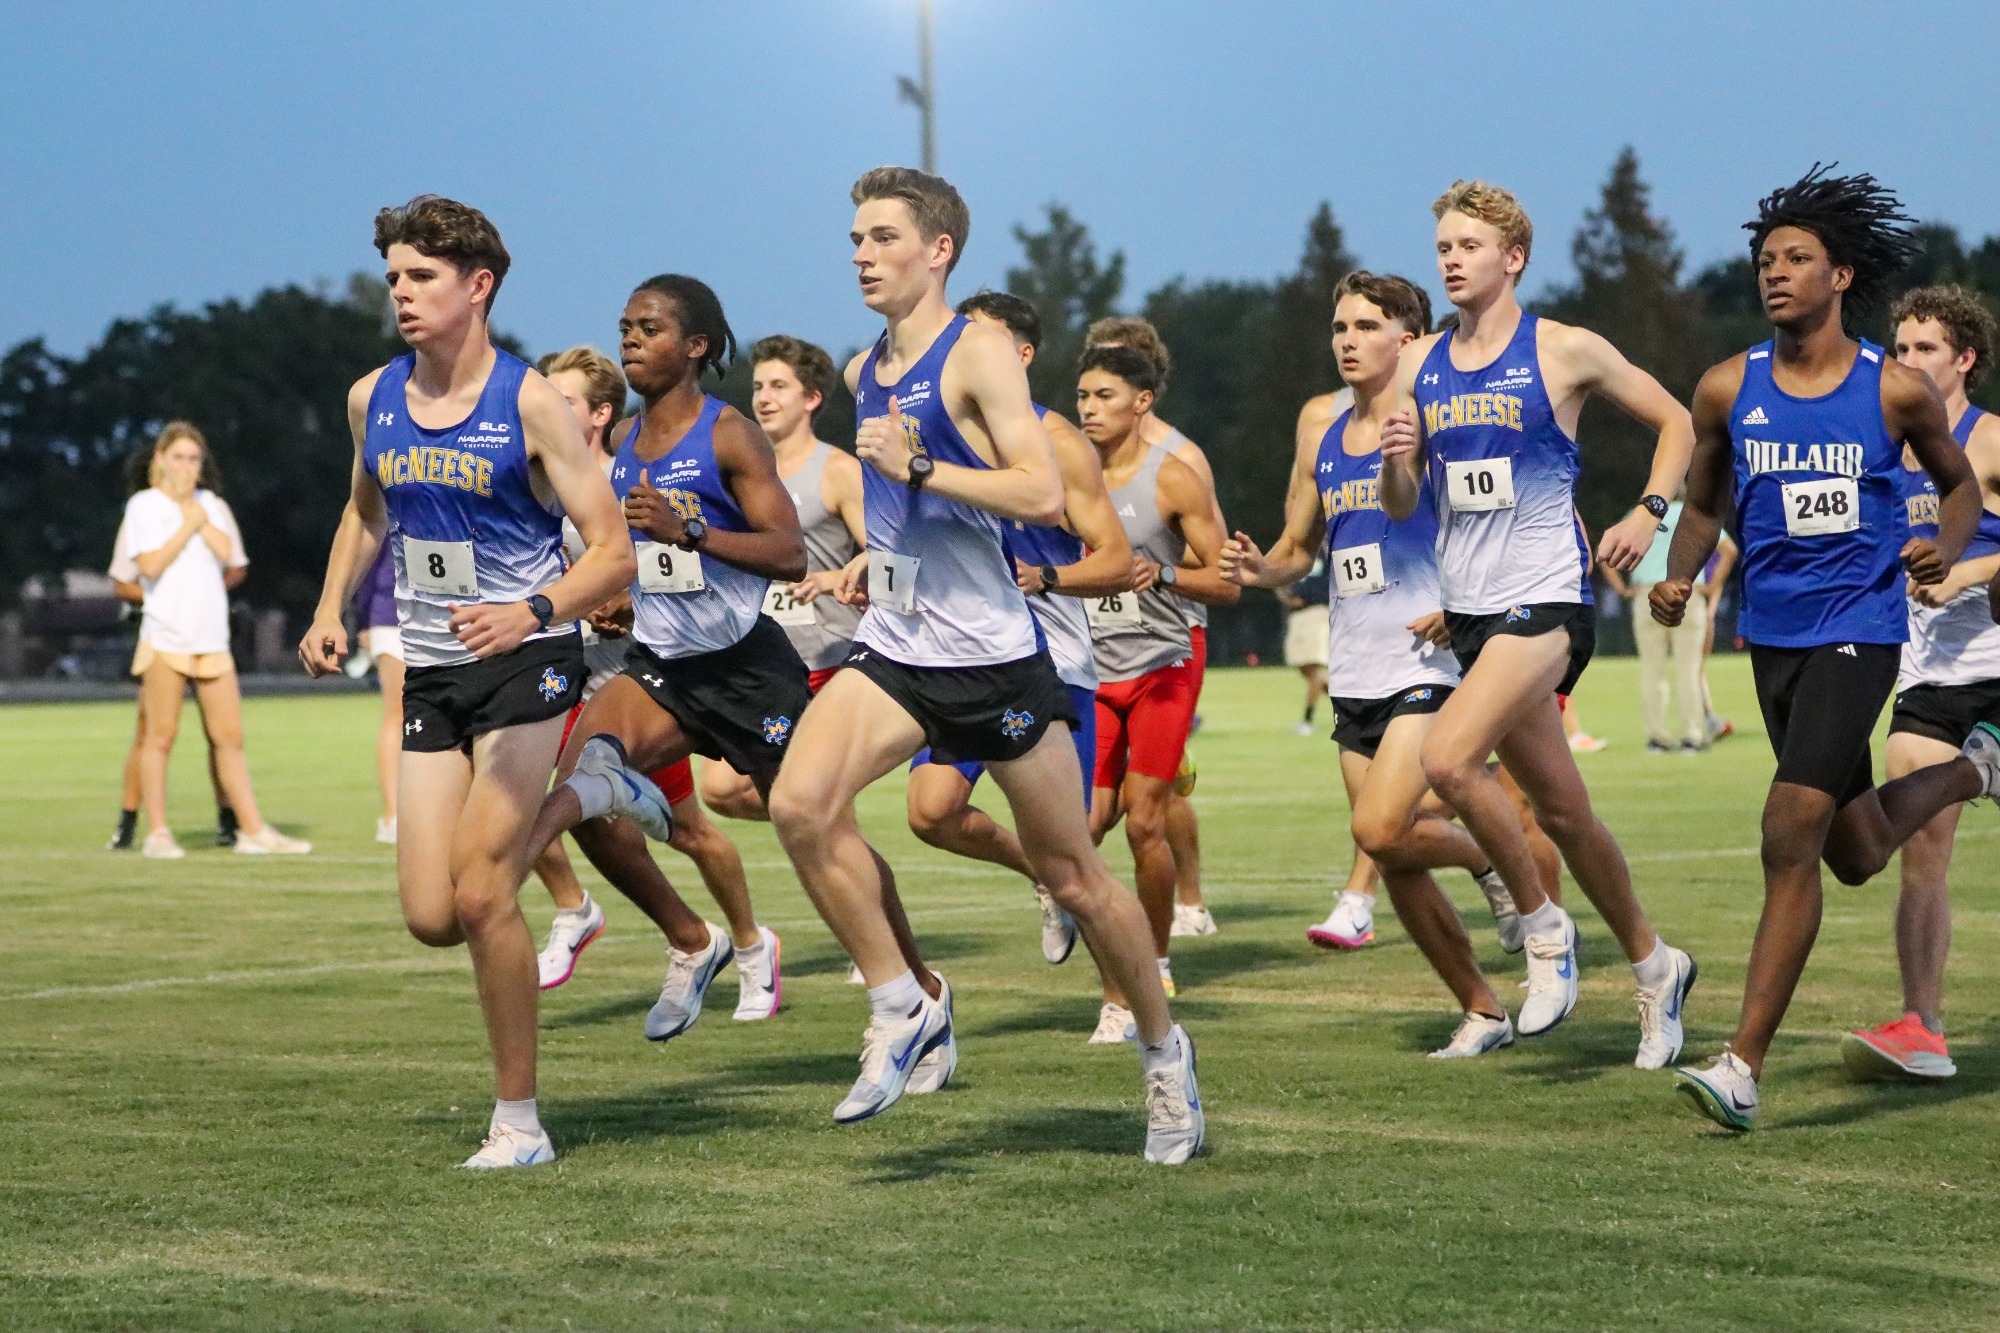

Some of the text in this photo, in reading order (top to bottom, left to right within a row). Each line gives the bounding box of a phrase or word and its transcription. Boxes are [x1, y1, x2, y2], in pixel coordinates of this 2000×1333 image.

[1485, 377, 1533, 388] NAVARRE
[457, 435, 511, 444] NAVARRE
[1744, 438, 1864, 479] DILLARD
[1463, 470, 1494, 495] 10
[1795, 490, 1849, 519] 248
[427, 552, 446, 579] 8
[657, 552, 673, 577] 9
[1342, 556, 1368, 581] 13
[884, 564, 894, 592] 7
[1098, 595, 1123, 613] 26
